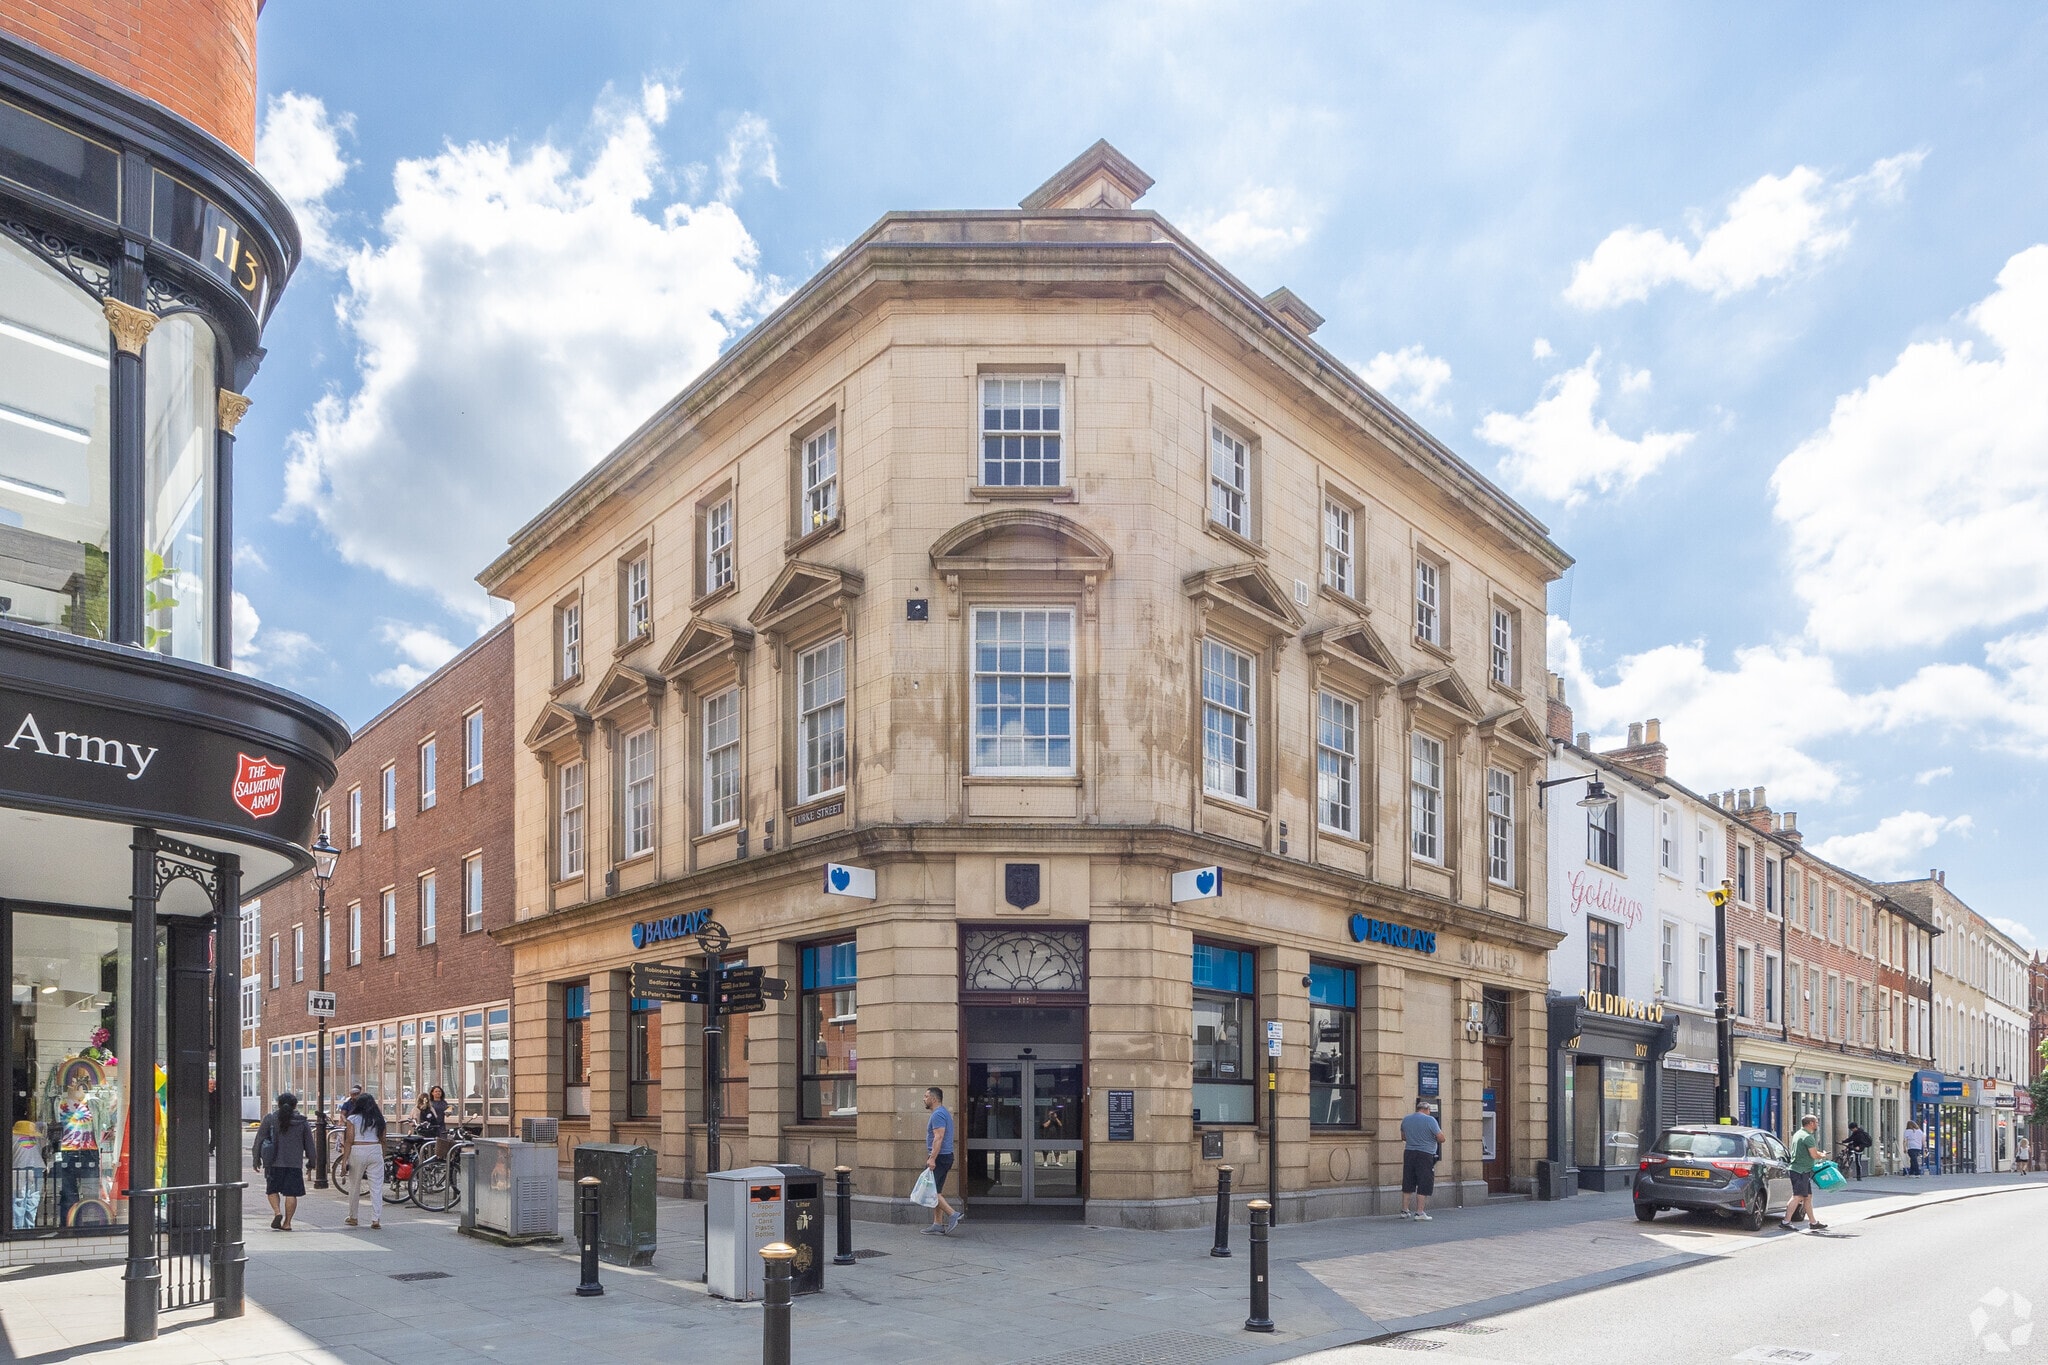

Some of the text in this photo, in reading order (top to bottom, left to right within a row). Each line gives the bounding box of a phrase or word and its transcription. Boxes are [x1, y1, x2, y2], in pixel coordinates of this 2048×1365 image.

[214, 225, 259, 291] 113
[3, 712, 159, 781] Army
[248, 765, 267, 779] THE
[236, 774, 282, 797] SALVATION
[250, 791, 277, 810] ARMY
[795, 802, 843, 826] LURKE STREET
[1567, 870, 1643, 931] Goldings
[645, 908, 709, 944] BARCLAYS
[1370, 919, 1437, 954] BARCLAYS
[644, 966, 681, 976] Robinson Pool
[648, 979, 669, 987] Bedford
[647, 990, 666, 998] Peter's
[1638, 1000, 1646, 1020] &
[1647, 1003, 1663, 1023] CO
[1568, 1036, 1581, 1049] 07
[1635, 1043, 1648, 1057] 107
[1674, 1168, 1690, 1176] KO18
